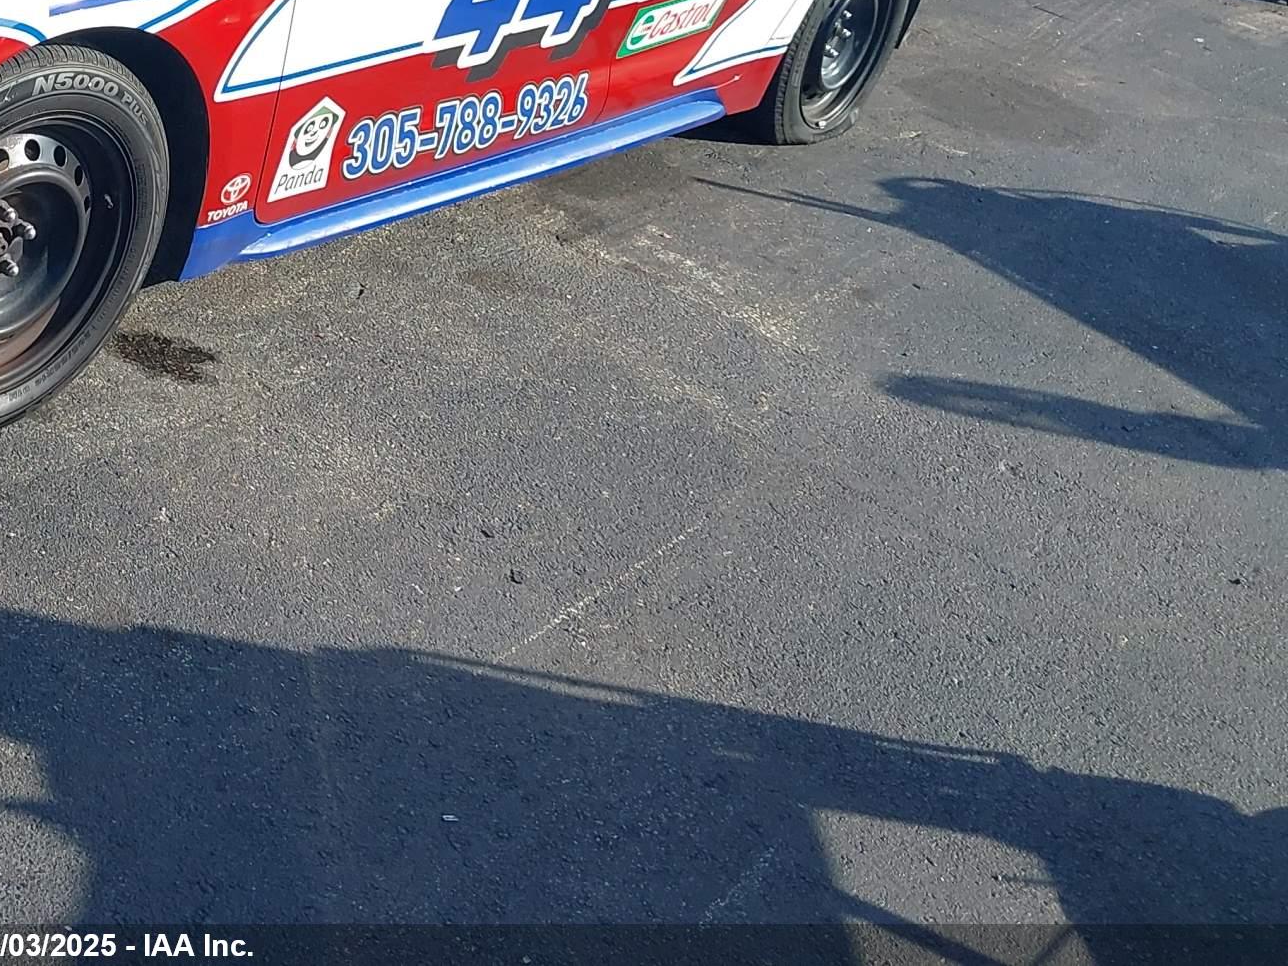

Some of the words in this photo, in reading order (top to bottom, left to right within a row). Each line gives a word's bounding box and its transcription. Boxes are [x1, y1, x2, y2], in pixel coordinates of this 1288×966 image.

[31, 72, 120, 97] N5000
[342, 72, 590, 181] 305-788-9326
[273, 165, 325, 195] Panda
[207, 201, 249, 222] TOYOTA
